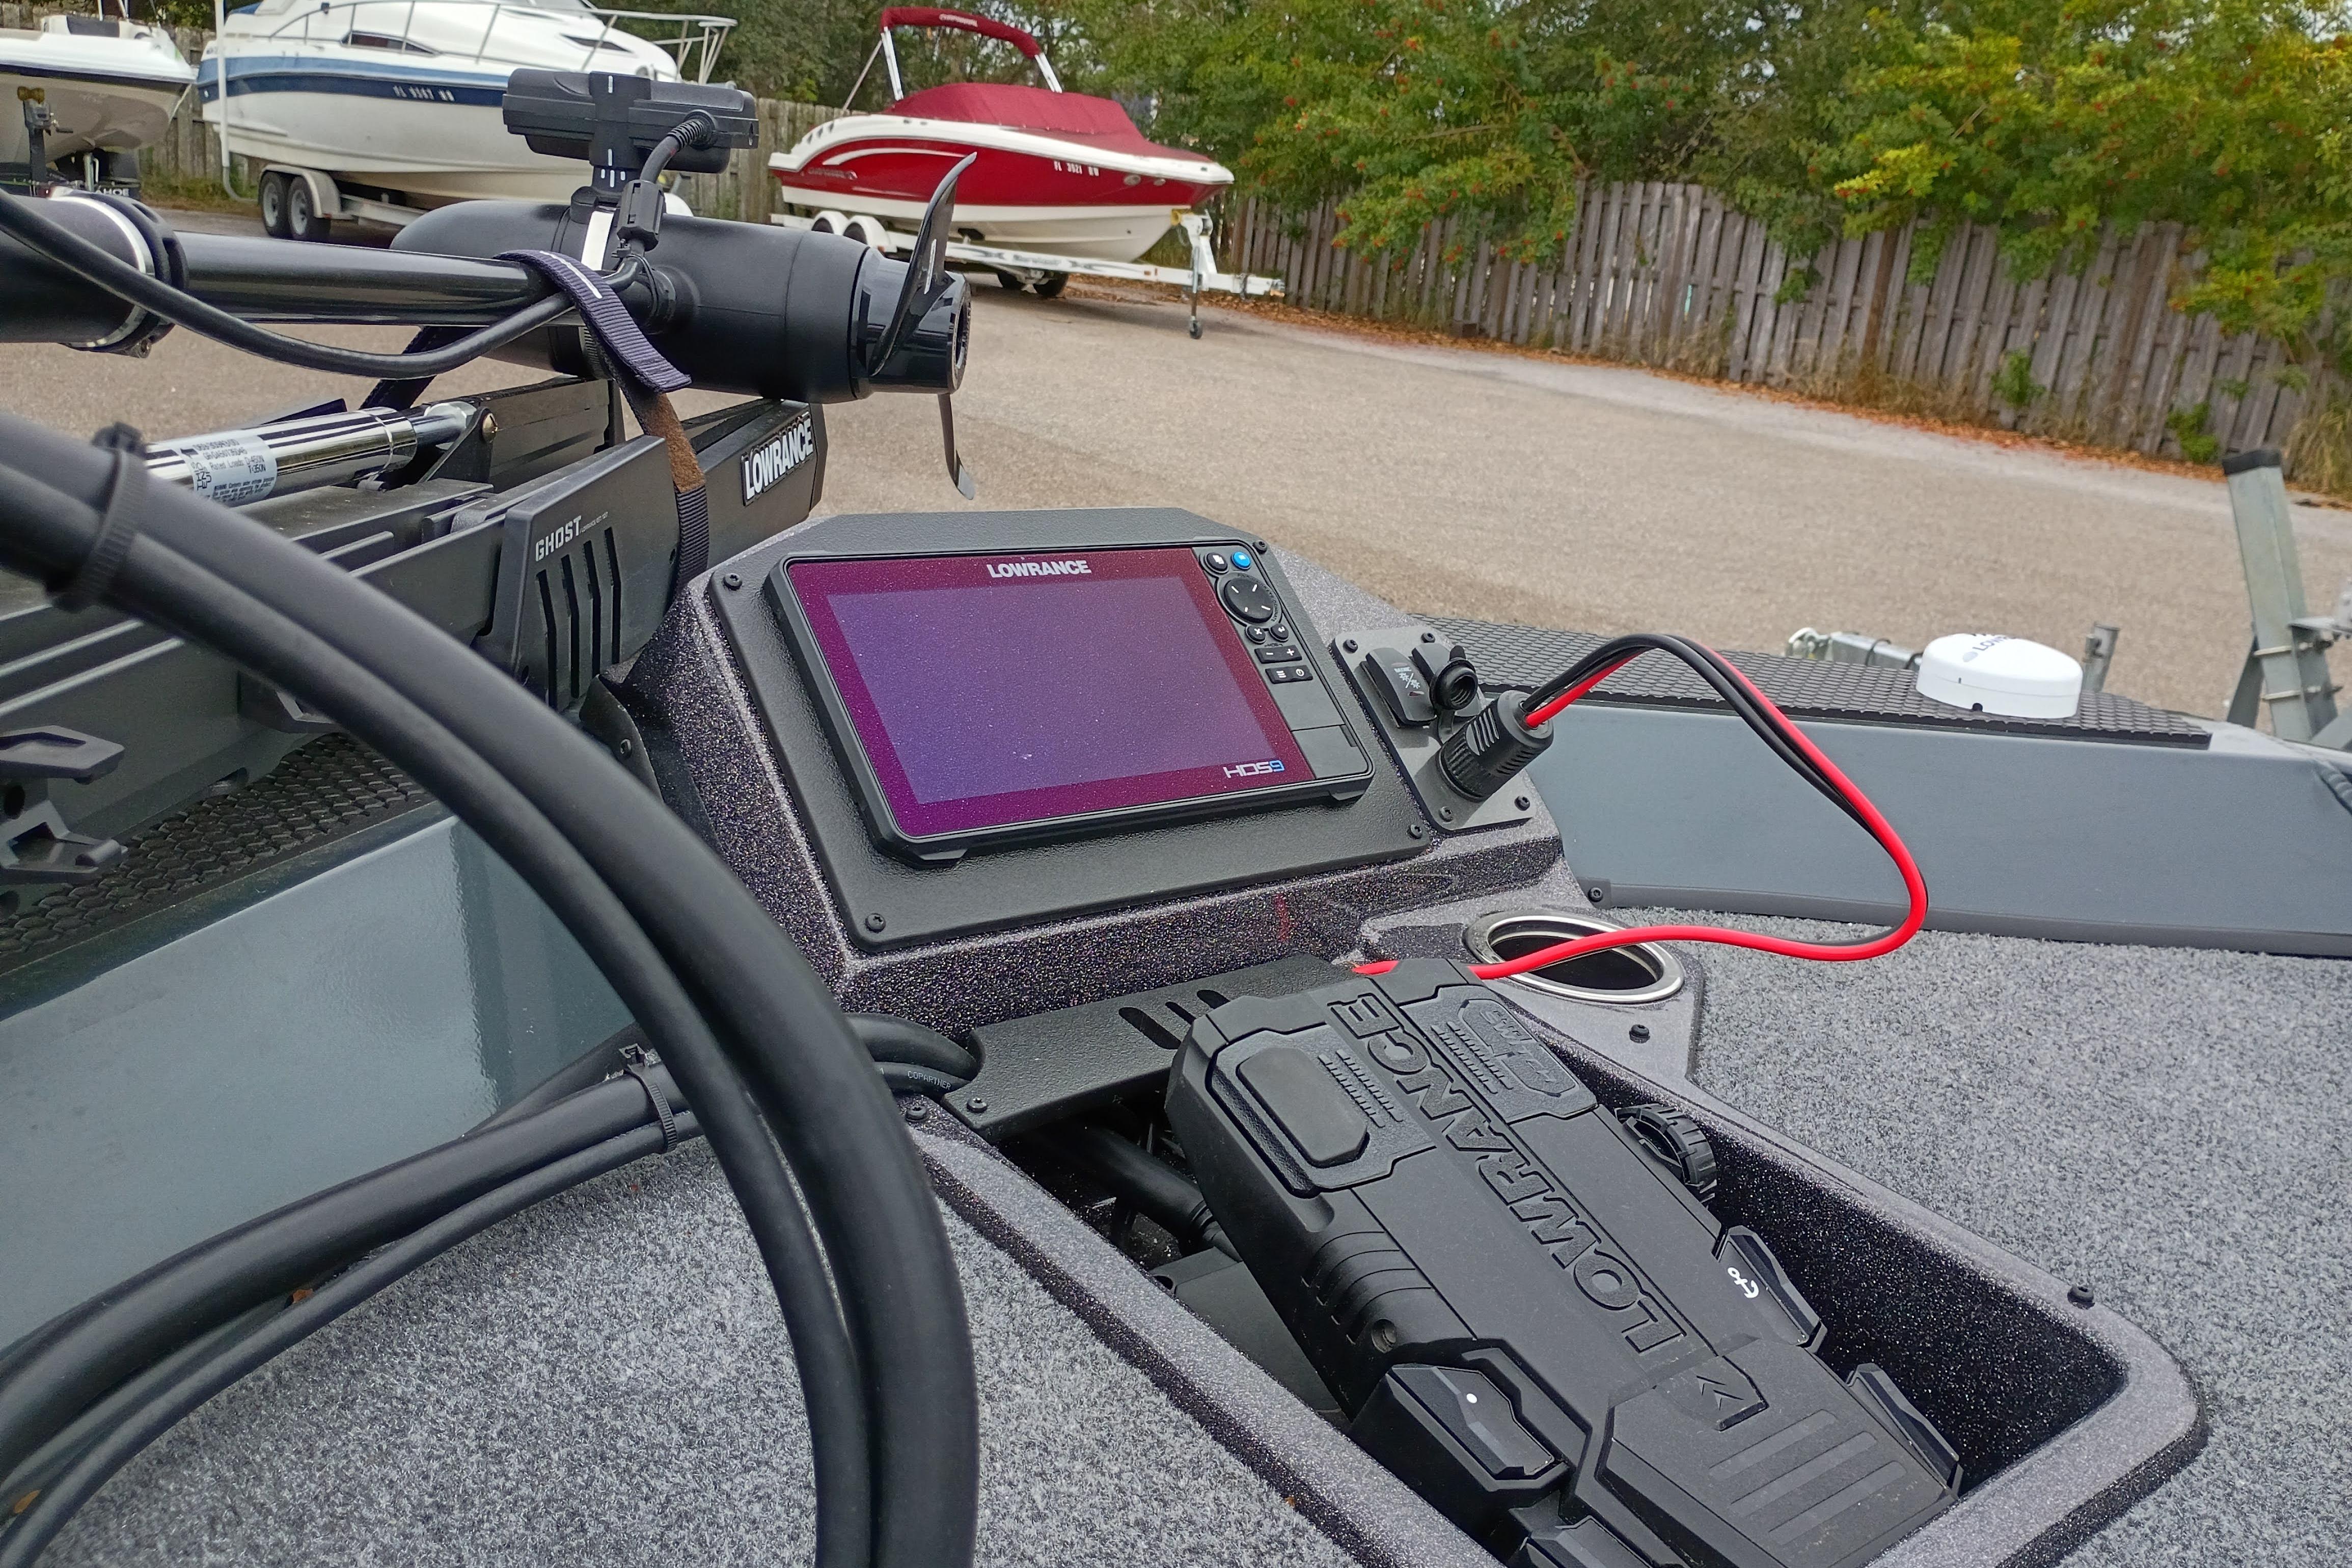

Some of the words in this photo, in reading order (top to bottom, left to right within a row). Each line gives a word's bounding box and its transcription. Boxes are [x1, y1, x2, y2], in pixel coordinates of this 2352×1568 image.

[745, 418, 813, 500] LOWRANCE
[535, 515, 582, 562] GHOST
[986, 560, 1092, 578] LOWRANCE
[1223, 760, 1285, 779] HDS9
[1327, 993, 1687, 1353] LOWRANCE
